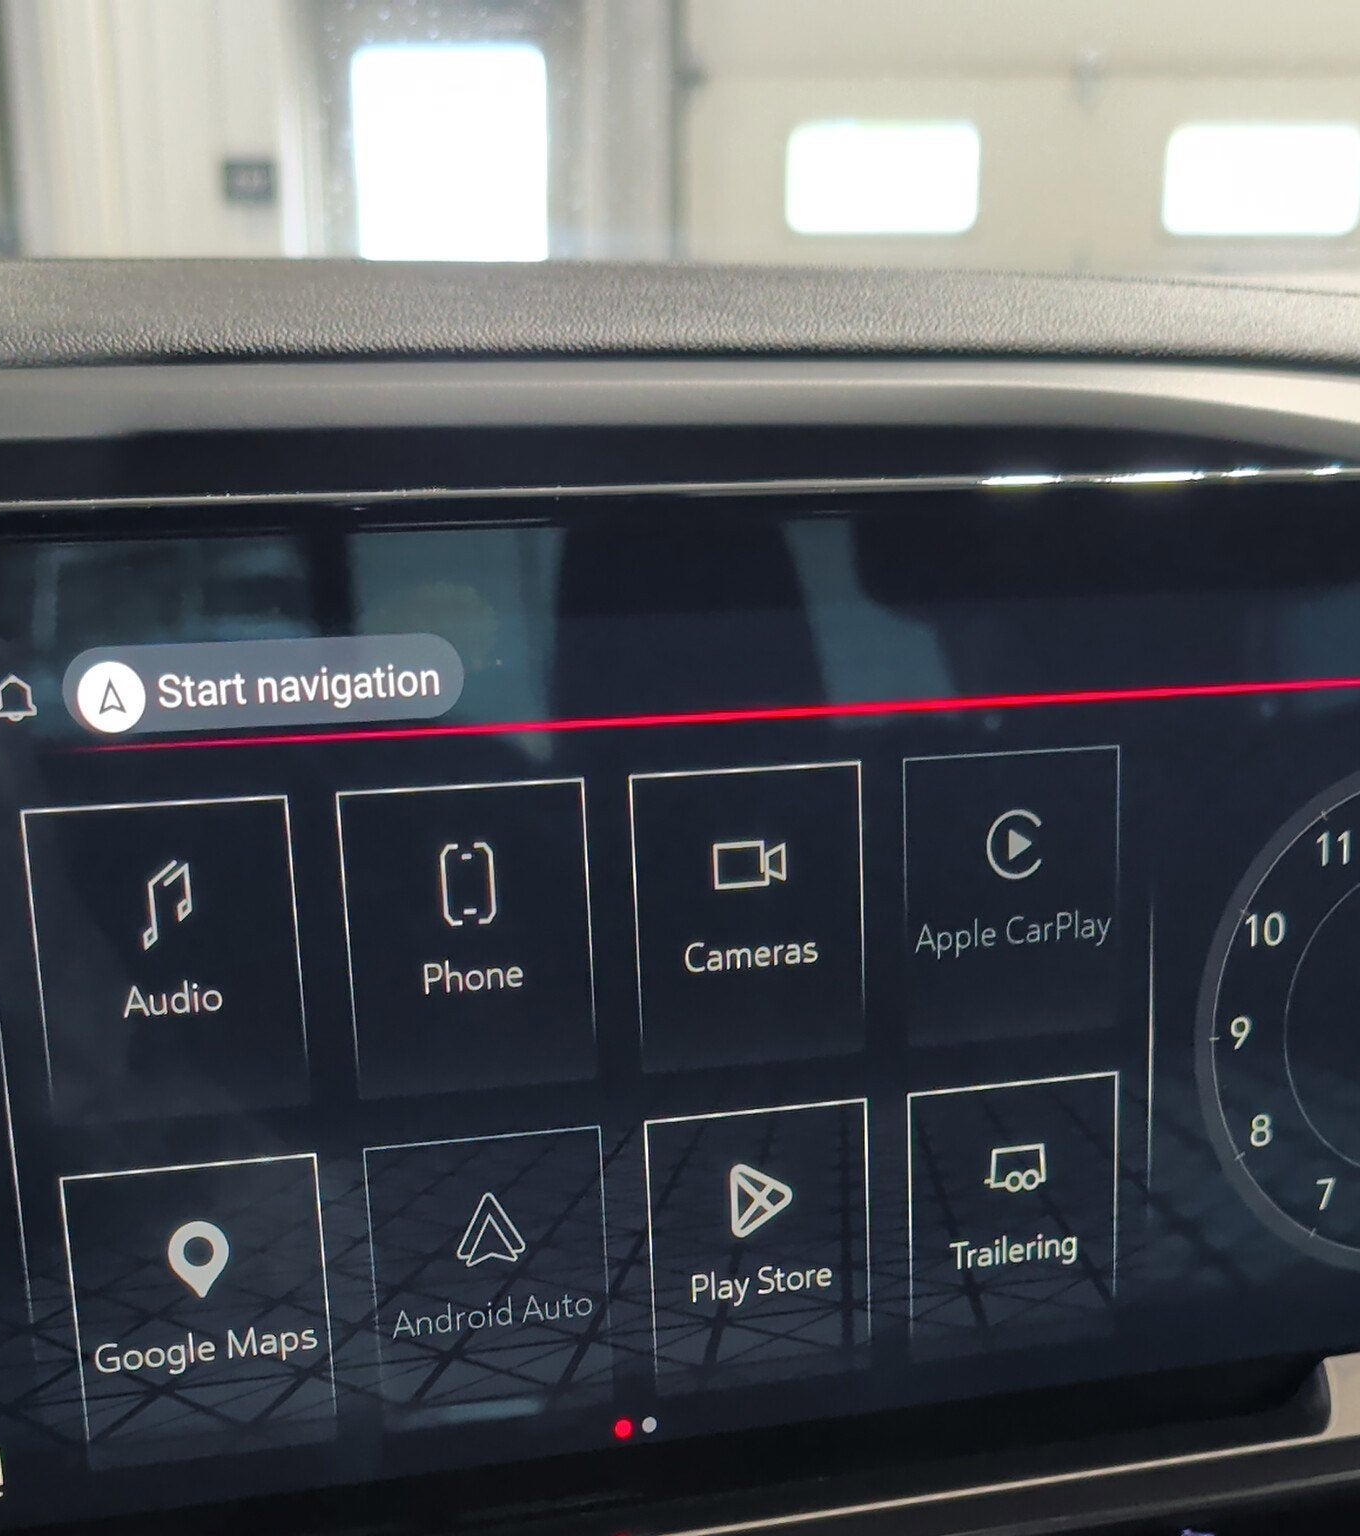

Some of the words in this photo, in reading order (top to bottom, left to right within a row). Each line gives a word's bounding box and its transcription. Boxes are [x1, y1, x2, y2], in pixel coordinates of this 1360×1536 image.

[159, 673, 246, 708] Start
[258, 664, 439, 708] navigation
[1317, 831, 1349, 866] 11
[916, 918, 996, 959] Apple
[1007, 910, 1111, 946] CarPlay
[1246, 913, 1285, 946] 10
[685, 942, 818, 972] Cameras
[424, 960, 523, 994] Phone
[124, 980, 222, 1018] Audio
[1231, 1017, 1250, 1049] 9
[1251, 1115, 1271, 1146] 8
[1317, 1178, 1335, 1210] 7
[950, 1234, 1077, 1269] Trailering
[692, 1272, 749, 1306] Play
[758, 1266, 832, 1294] Store
[393, 1296, 512, 1339] Android
[523, 1294, 592, 1323] Auto
[95, 1333, 215, 1374] Google
[228, 1327, 317, 1360] Maps
